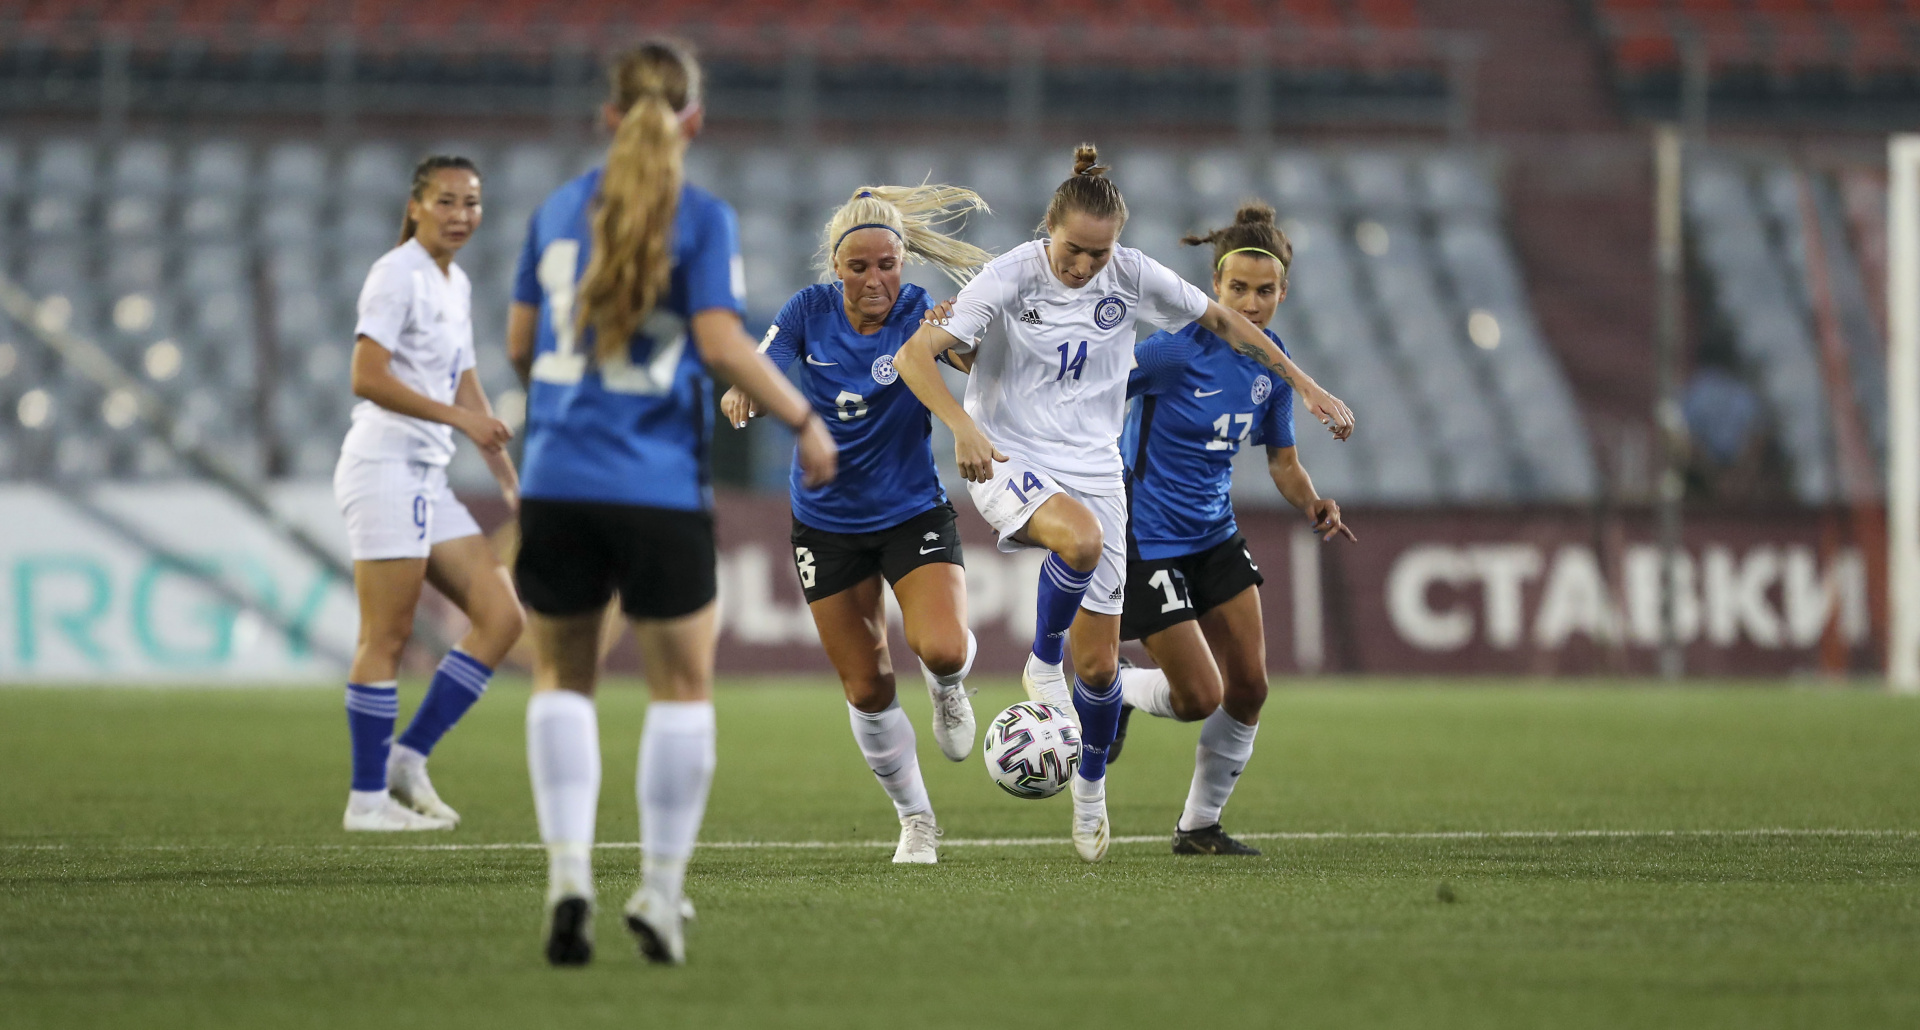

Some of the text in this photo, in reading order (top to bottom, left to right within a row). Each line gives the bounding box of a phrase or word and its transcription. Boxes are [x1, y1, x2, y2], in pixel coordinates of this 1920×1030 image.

[1056, 340, 1088, 381] 14
[1206, 412, 1254, 451] 17
[1005, 471, 1045, 505] 14
[413, 495, 427, 541] 9
[796, 547, 816, 589] 8
[1386, 543, 1869, 652] СТАВКИ
